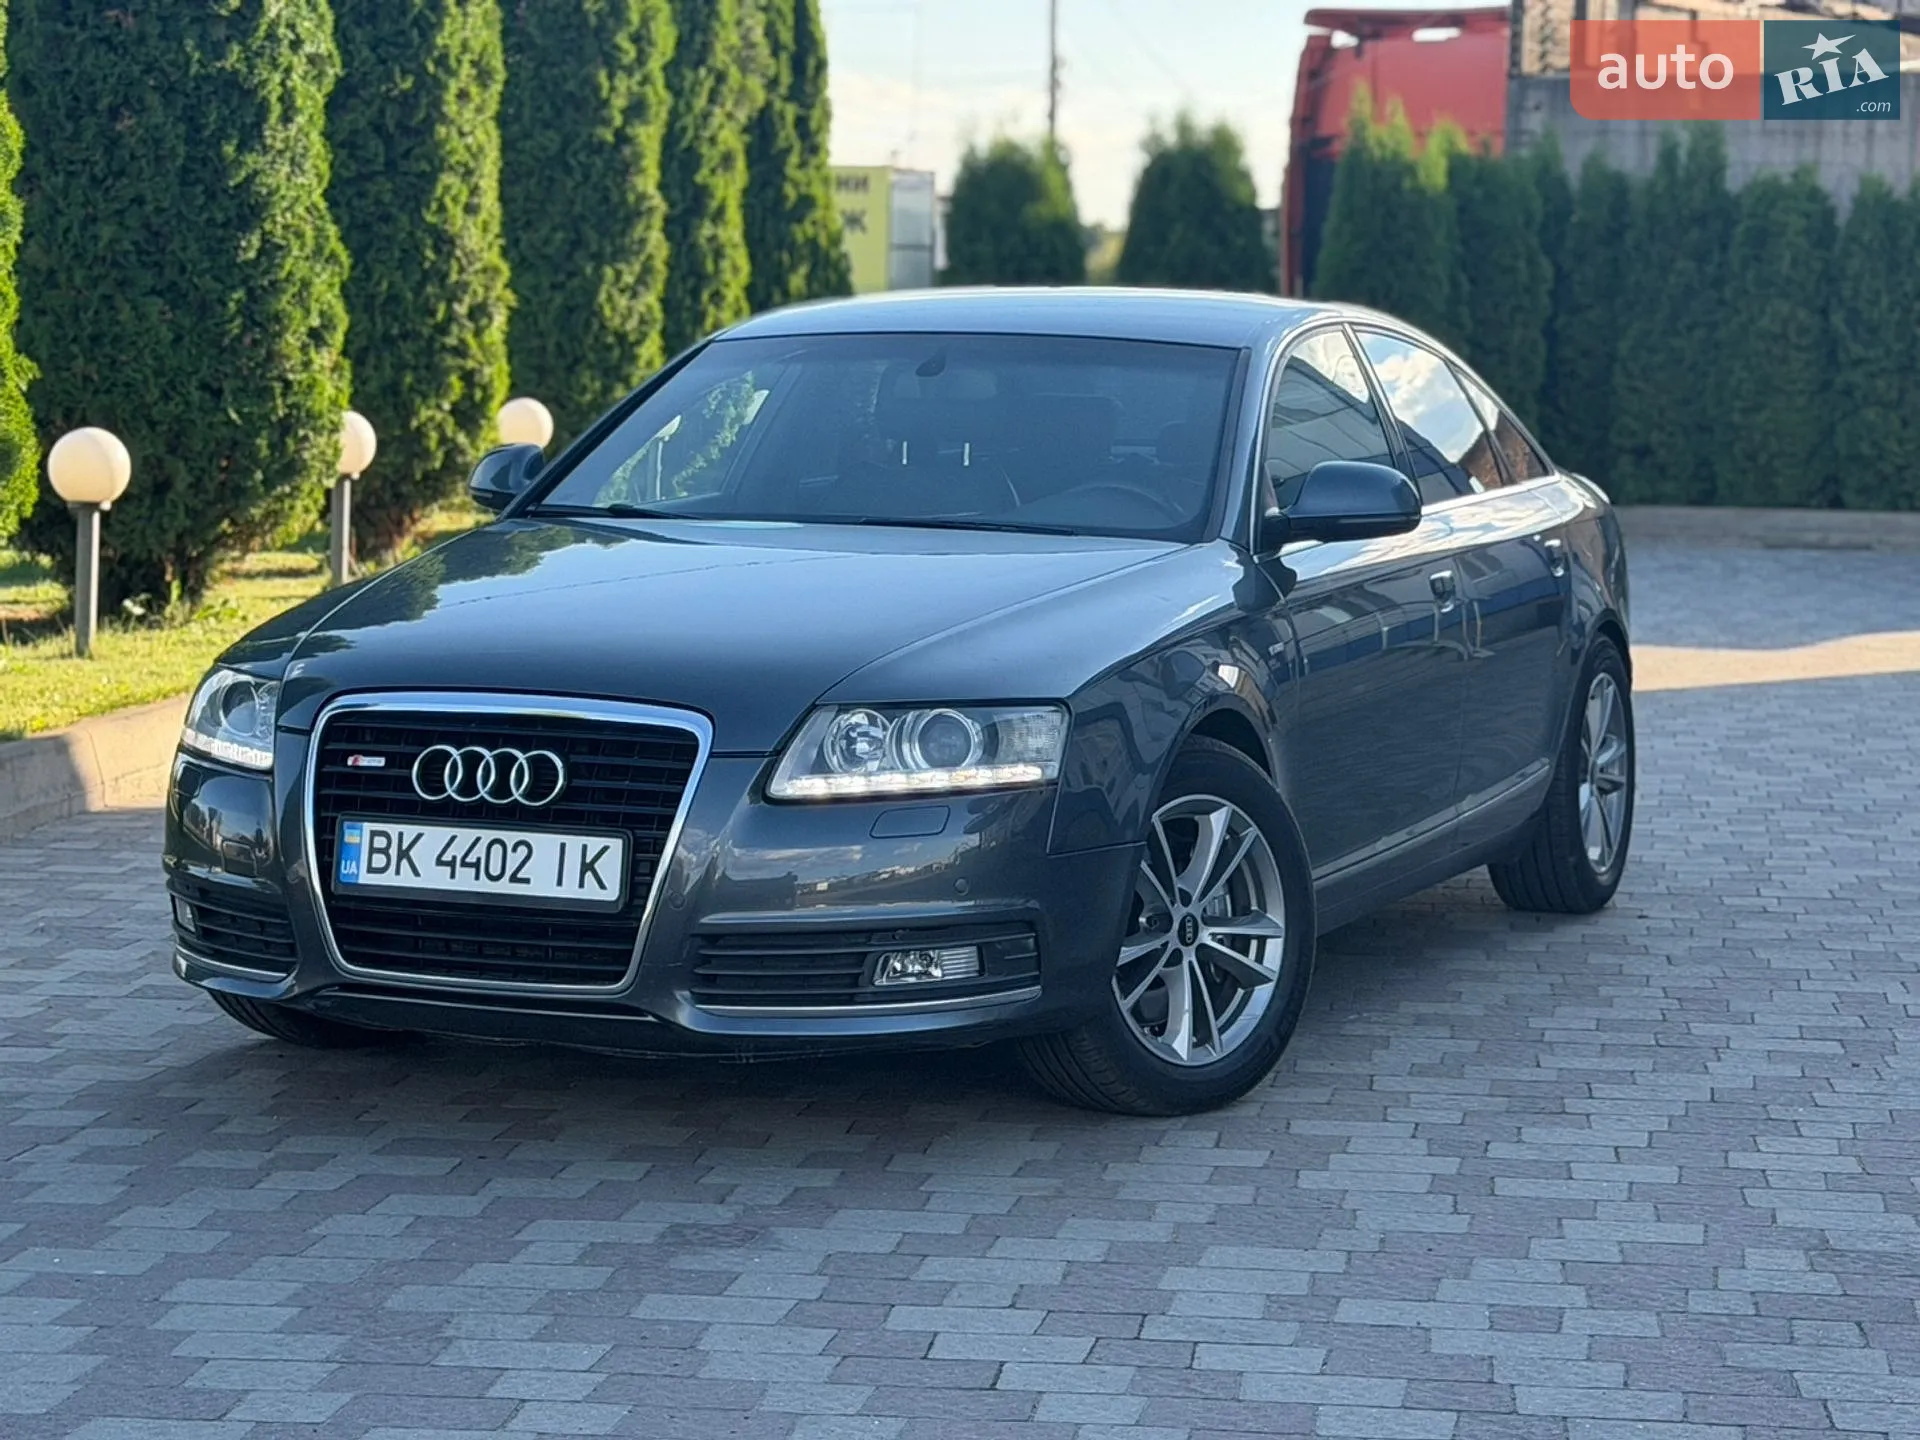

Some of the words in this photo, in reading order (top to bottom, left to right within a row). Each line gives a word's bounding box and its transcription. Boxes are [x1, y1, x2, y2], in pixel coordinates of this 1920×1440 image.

[341, 861, 358, 875] UA
[366, 829, 425, 878] BK
[435, 834, 534, 885] 4402
[556, 841, 611, 891] IK
